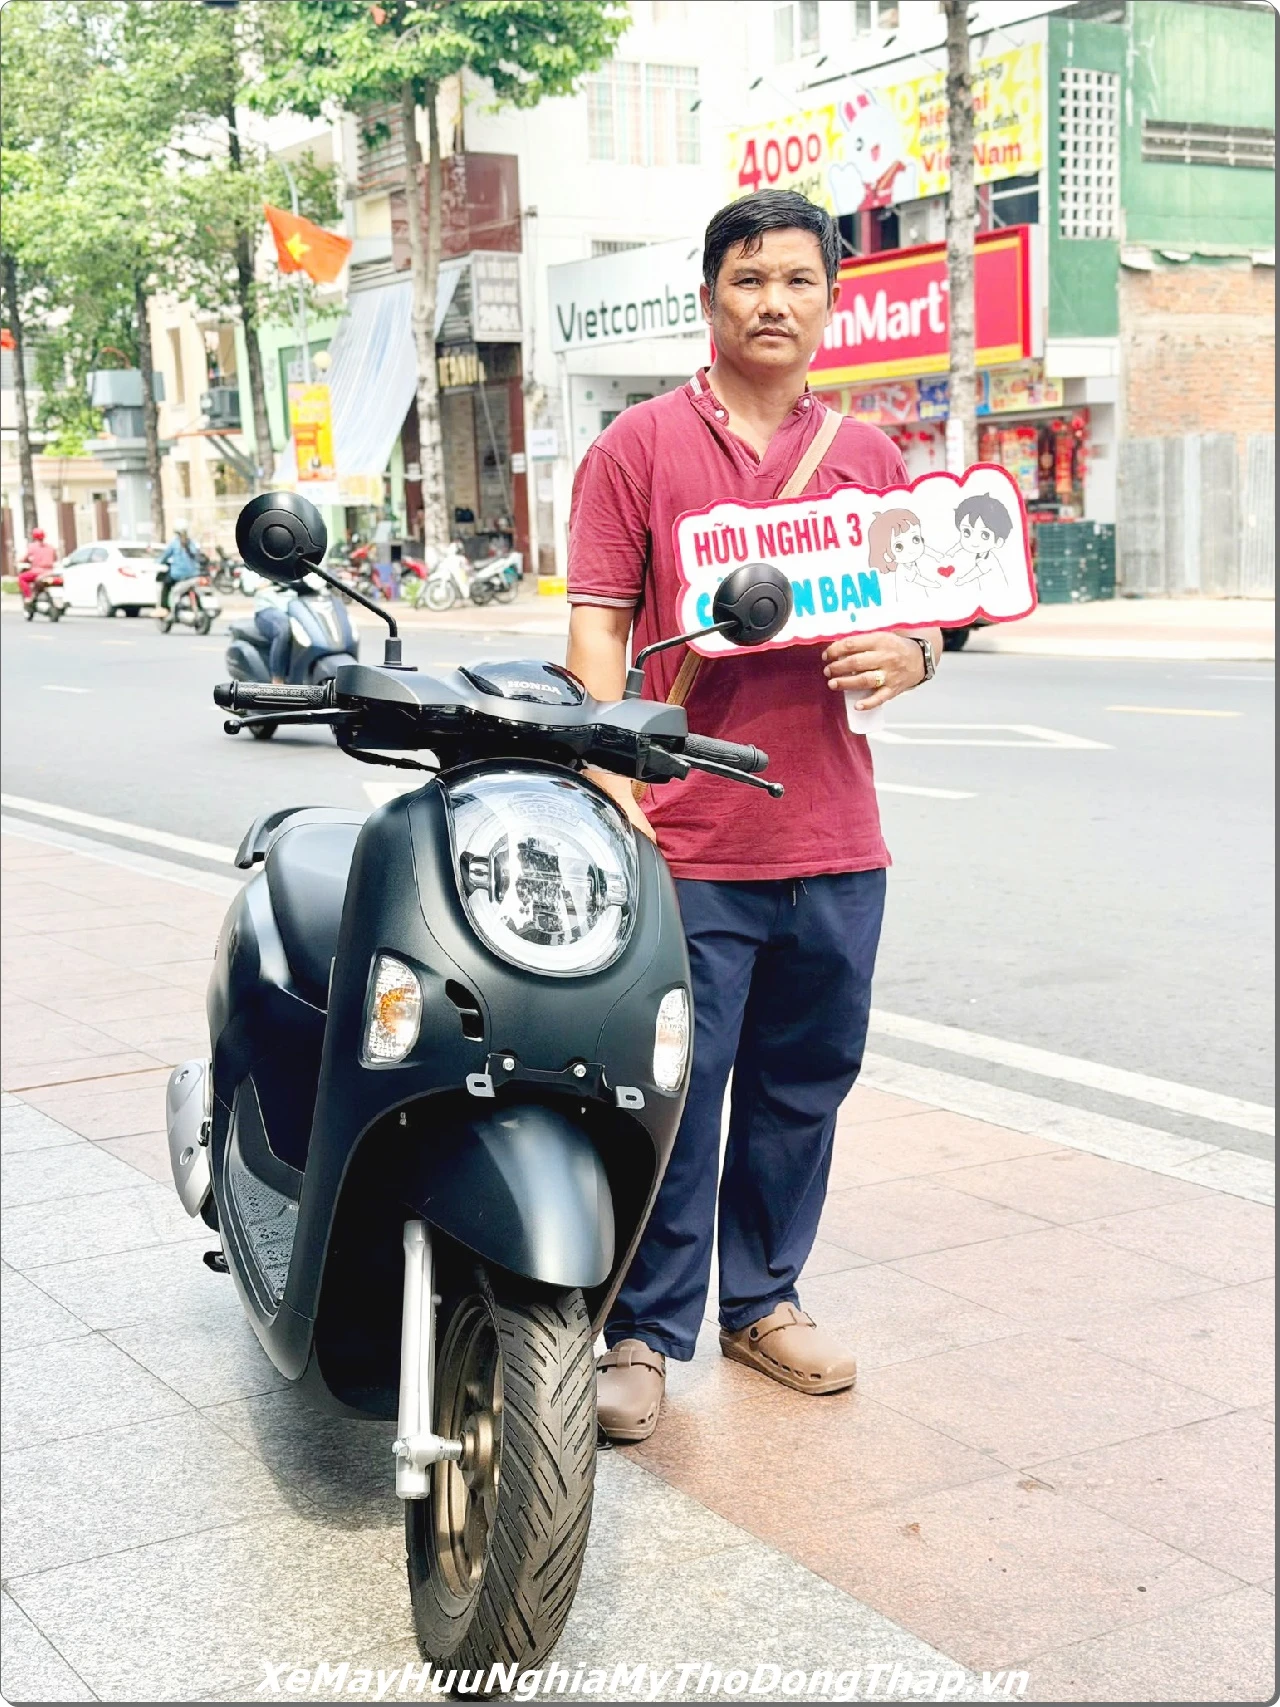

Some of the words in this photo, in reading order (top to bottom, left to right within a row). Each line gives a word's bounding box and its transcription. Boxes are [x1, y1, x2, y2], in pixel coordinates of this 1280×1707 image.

[738, 133, 823, 192] 4000
[556, 283, 705, 343] Vietcomba
[693, 521, 749, 566] HỮU
[756, 510, 841, 559] NGHĨA
[846, 512, 863, 547] 3
[790, 578, 816, 618] N
[818, 569, 882, 623] BẠN
[507, 680, 562, 695] HONDA
